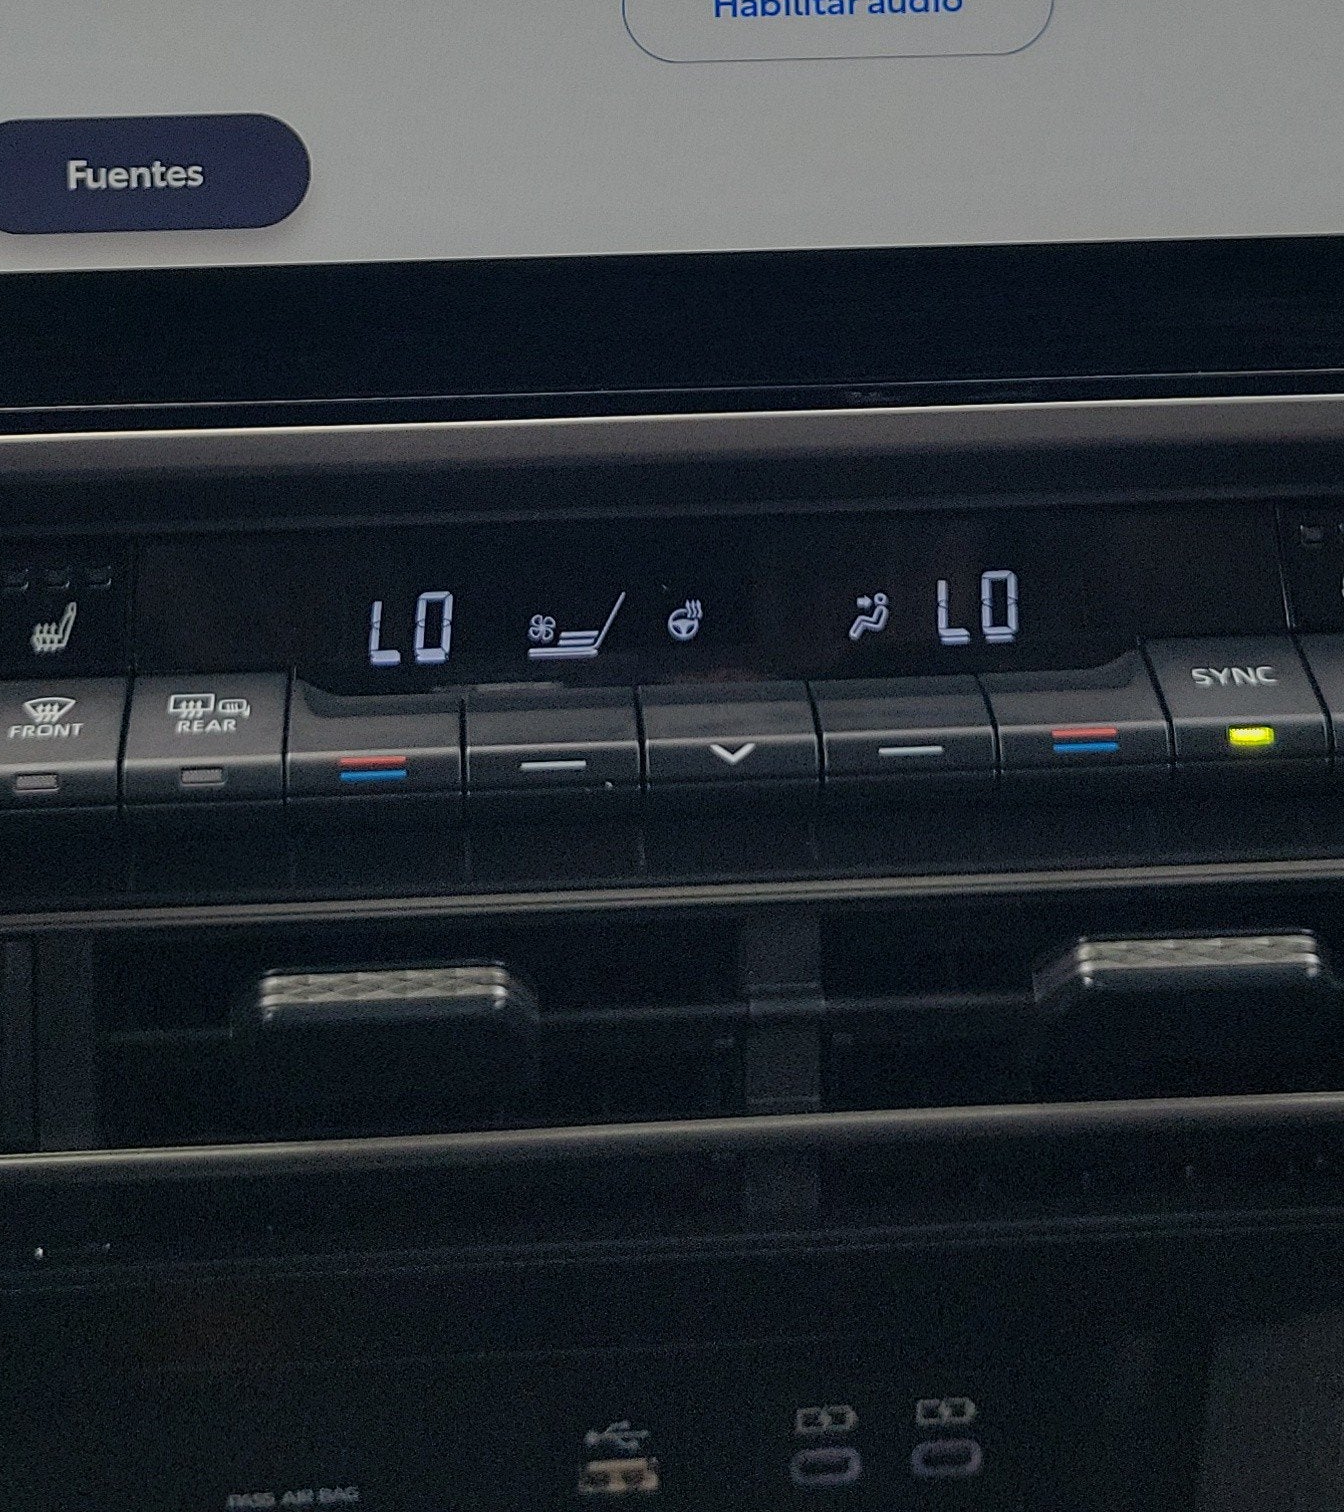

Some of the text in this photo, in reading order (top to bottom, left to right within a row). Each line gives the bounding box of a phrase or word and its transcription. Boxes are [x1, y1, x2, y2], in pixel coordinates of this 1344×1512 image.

[66, 159, 205, 192] Fuentes
[1191, 663, 1278, 688] SYNC
[8, 721, 85, 740] FRONT
[177, 717, 238, 735] REAR
